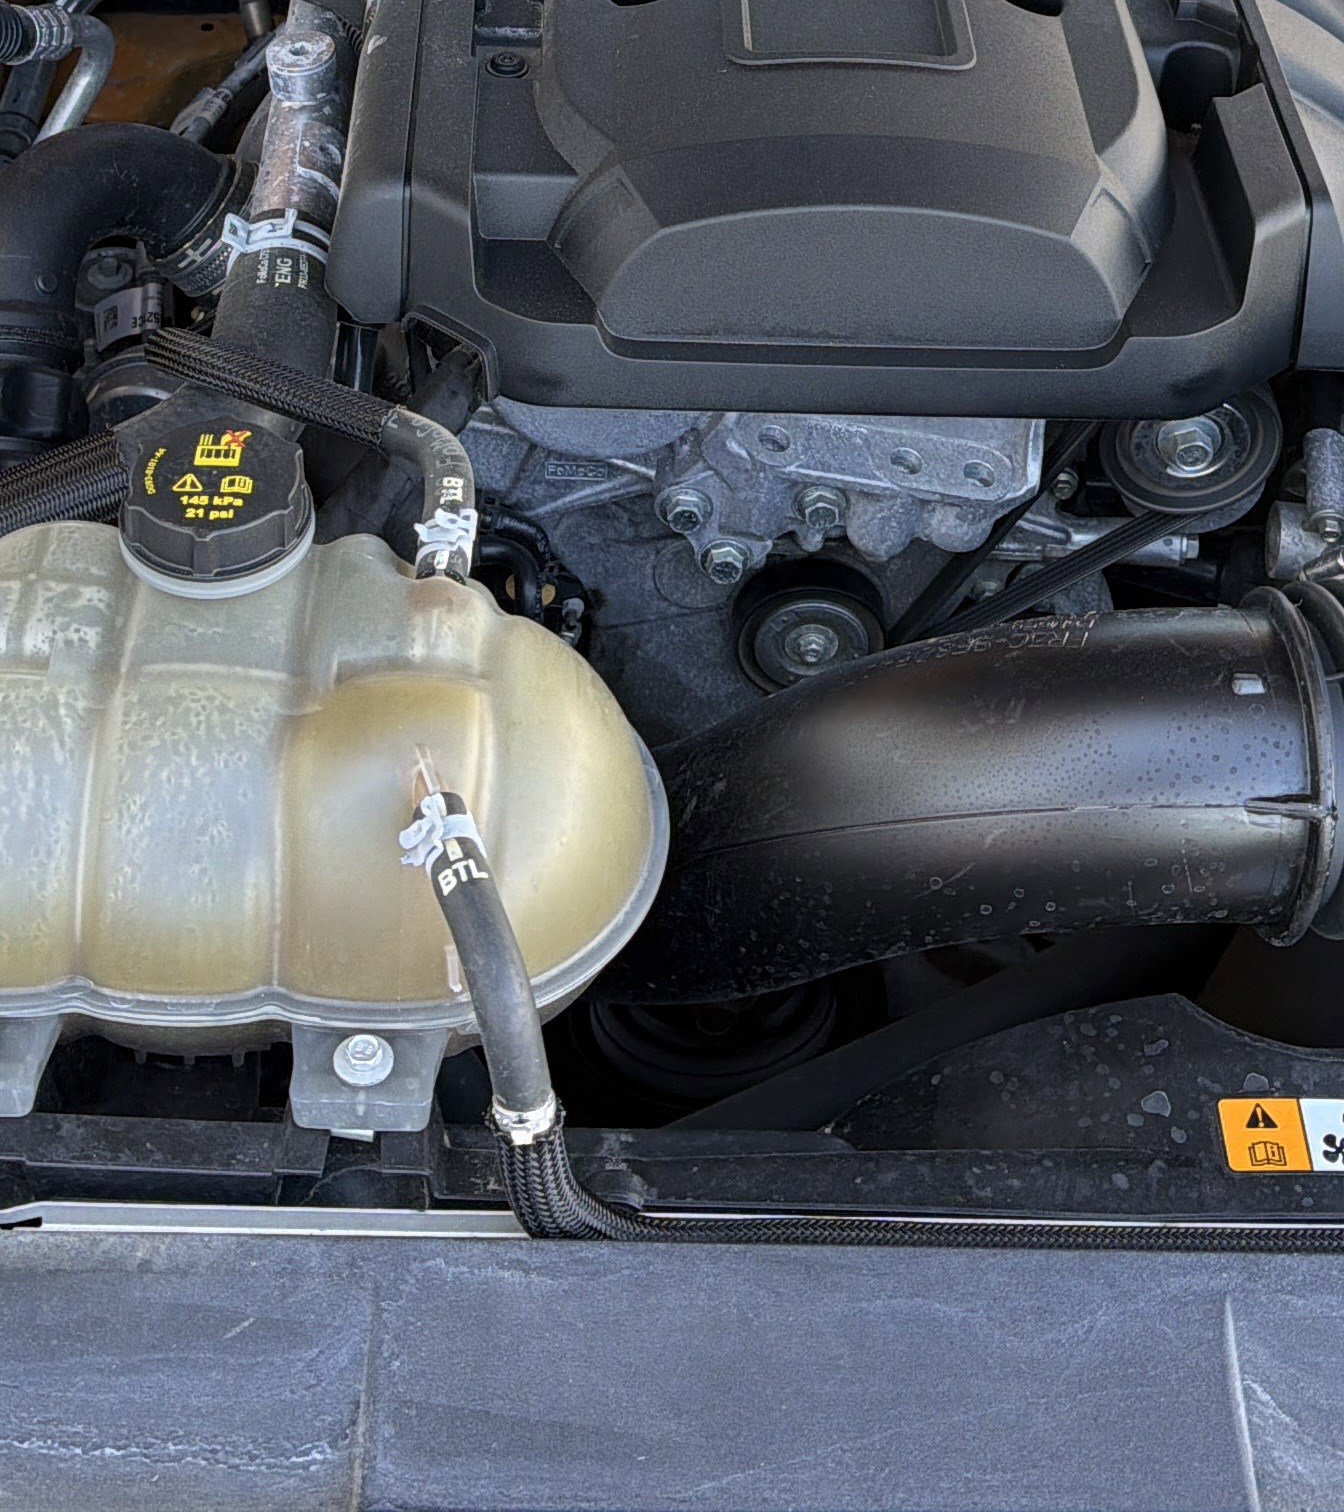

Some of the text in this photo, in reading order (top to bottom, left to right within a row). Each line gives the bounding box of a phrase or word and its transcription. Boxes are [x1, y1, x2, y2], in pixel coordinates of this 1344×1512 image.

[274, 257, 293, 284] ENG
[179, 494, 244, 507] 145 kPa
[184, 507, 235, 521] 21 psi
[437, 858, 489, 897] BTL
